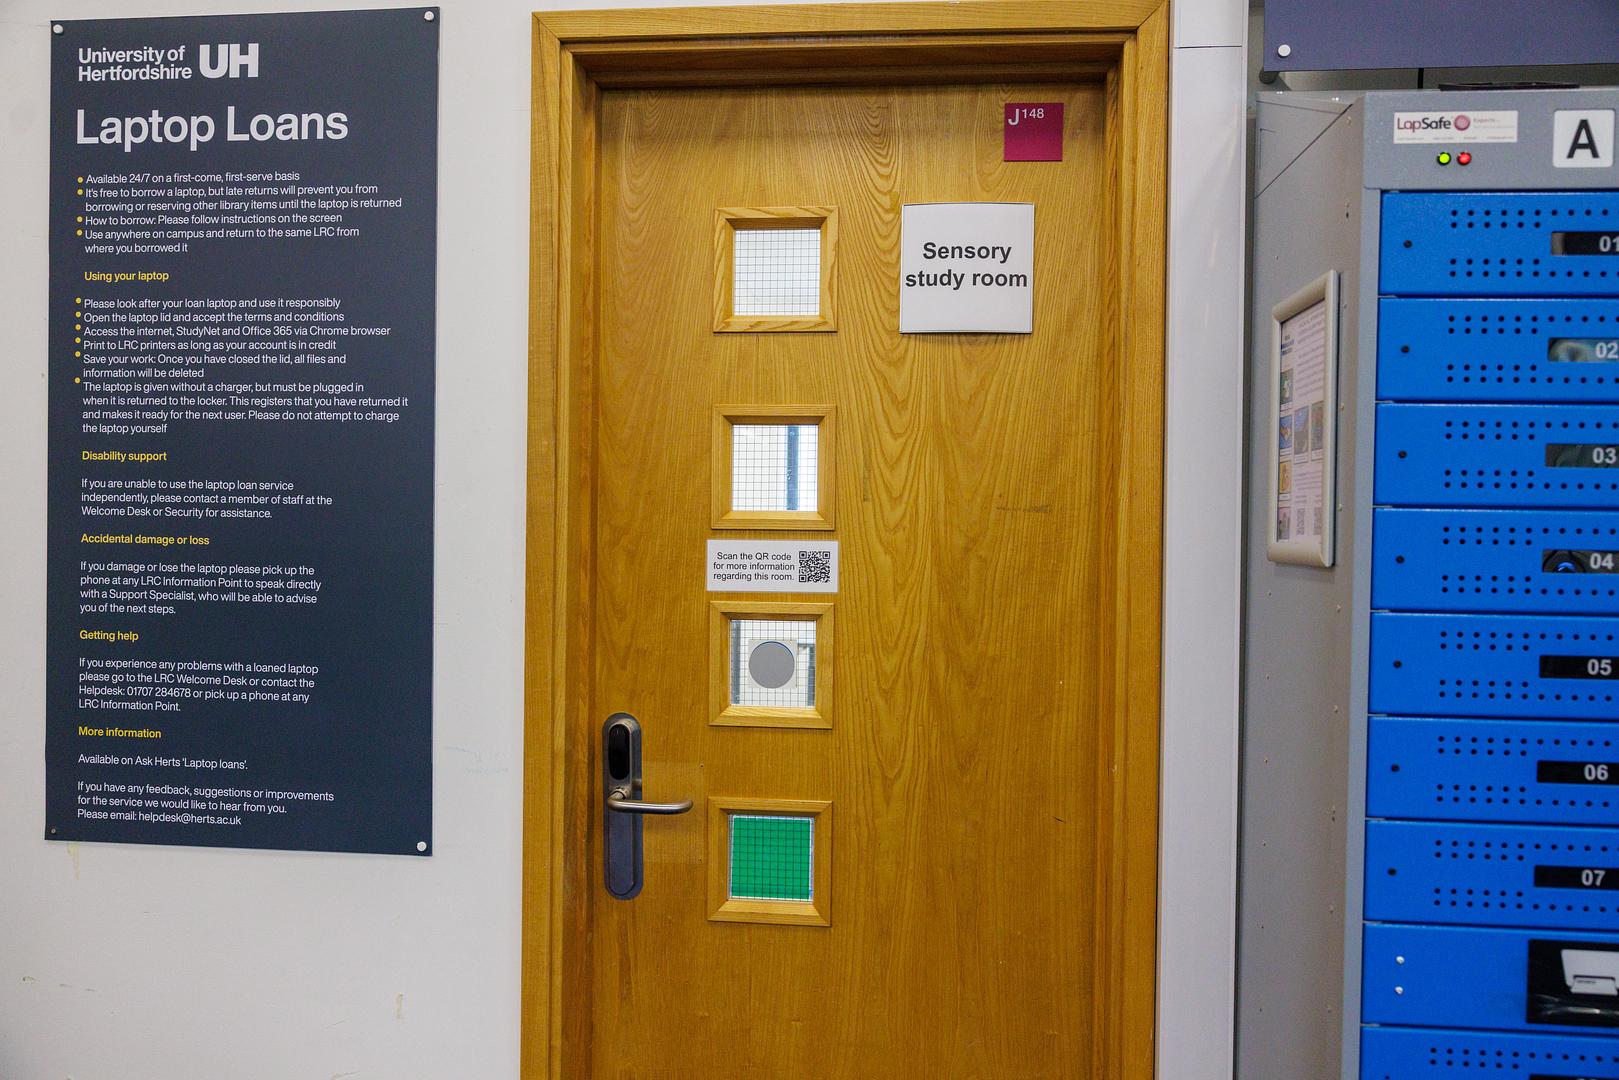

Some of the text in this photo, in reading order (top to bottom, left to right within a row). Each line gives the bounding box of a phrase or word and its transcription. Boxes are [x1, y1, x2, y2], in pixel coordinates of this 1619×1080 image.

[78, 45, 186, 65] University of
[199, 43, 259, 78] UH
[78, 64, 192, 81] Hertfordshire
[77, 105, 349, 152] Laptop Loans
[1566, 119, 1600, 159] A
[85, 171, 300, 184] Available 24/7 on a first-come, first-serve basis
[99, 188, 118, 198] free
[120, 188, 130, 197] to
[131, 187, 166, 197] borrow
[175, 187, 206, 198] laptop,
[208, 186, 224, 196] but
[225, 186, 243, 196] late
[245, 186, 279, 195] returns
[280, 185, 296, 195] will
[297, 185, 334, 197] prevent
[335, 186, 353, 197] you
[355, 184, 378, 194] from
[85, 213, 342, 225] How to borrow: Please follow instructions on the screen
[85, 242, 188, 255] where you borrowed it
[1599, 236, 1619, 252] 01
[923, 242, 1012, 264] Sensory
[85, 271, 169, 283] Using your laptop
[905, 269, 1028, 291] study room
[84, 297, 341, 310] Please look after your loan laptop and use it responsibly
[84, 325, 391, 338] Access the internet, StudyNet and Office 365 via Chrome browser
[1595, 342, 1619, 359] 02
[83, 368, 204, 378] information will be deleted
[82, 451, 167, 462] Disability support
[1593, 447, 1617, 464] 03
[81, 492, 149, 504] independently,
[150, 493, 182, 504] please
[183, 494, 219, 503] contact
[228, 494, 269, 504] member
[271, 494, 281, 504] of
[282, 495, 304, 504] staff
[305, 496, 315, 505] at
[316, 495, 333, 505] the
[81, 506, 125, 516] Welcome
[127, 506, 151, 516] Desk
[165, 507, 204, 519] Security
[205, 507, 219, 517] for
[220, 508, 272, 518] assistance.
[81, 533, 133, 543] Accidental
[135, 534, 175, 546] damage
[190, 535, 209, 545] loss
[716, 552, 792, 561] Scan the QR code
[1590, 553, 1614, 569] 04
[713, 561, 725, 570] for
[749, 562, 795, 571] information
[80, 576, 321, 591] phone at any LRC Information Point to speak directly
[713, 572, 752, 582] regarding
[754, 572, 769, 580] this
[80, 603, 176, 616] you of the next steps.
[80, 630, 139, 642] Getting help
[1587, 660, 1612, 675] 05
[79, 685, 310, 704] Helpdesk: 01707 284678 or pick up a phone at any
[79, 699, 181, 711] LRC Information Point.
[79, 726, 161, 738] More information
[78, 754, 119, 764] Available
[121, 757, 133, 765] on
[135, 756, 153, 766] Ask
[155, 757, 181, 767] Herts
[1585, 765, 1608, 780] 06
[77, 809, 242, 825] Please email: helpdesk@herts.ac.uk
[1582, 870, 1605, 885] 07
